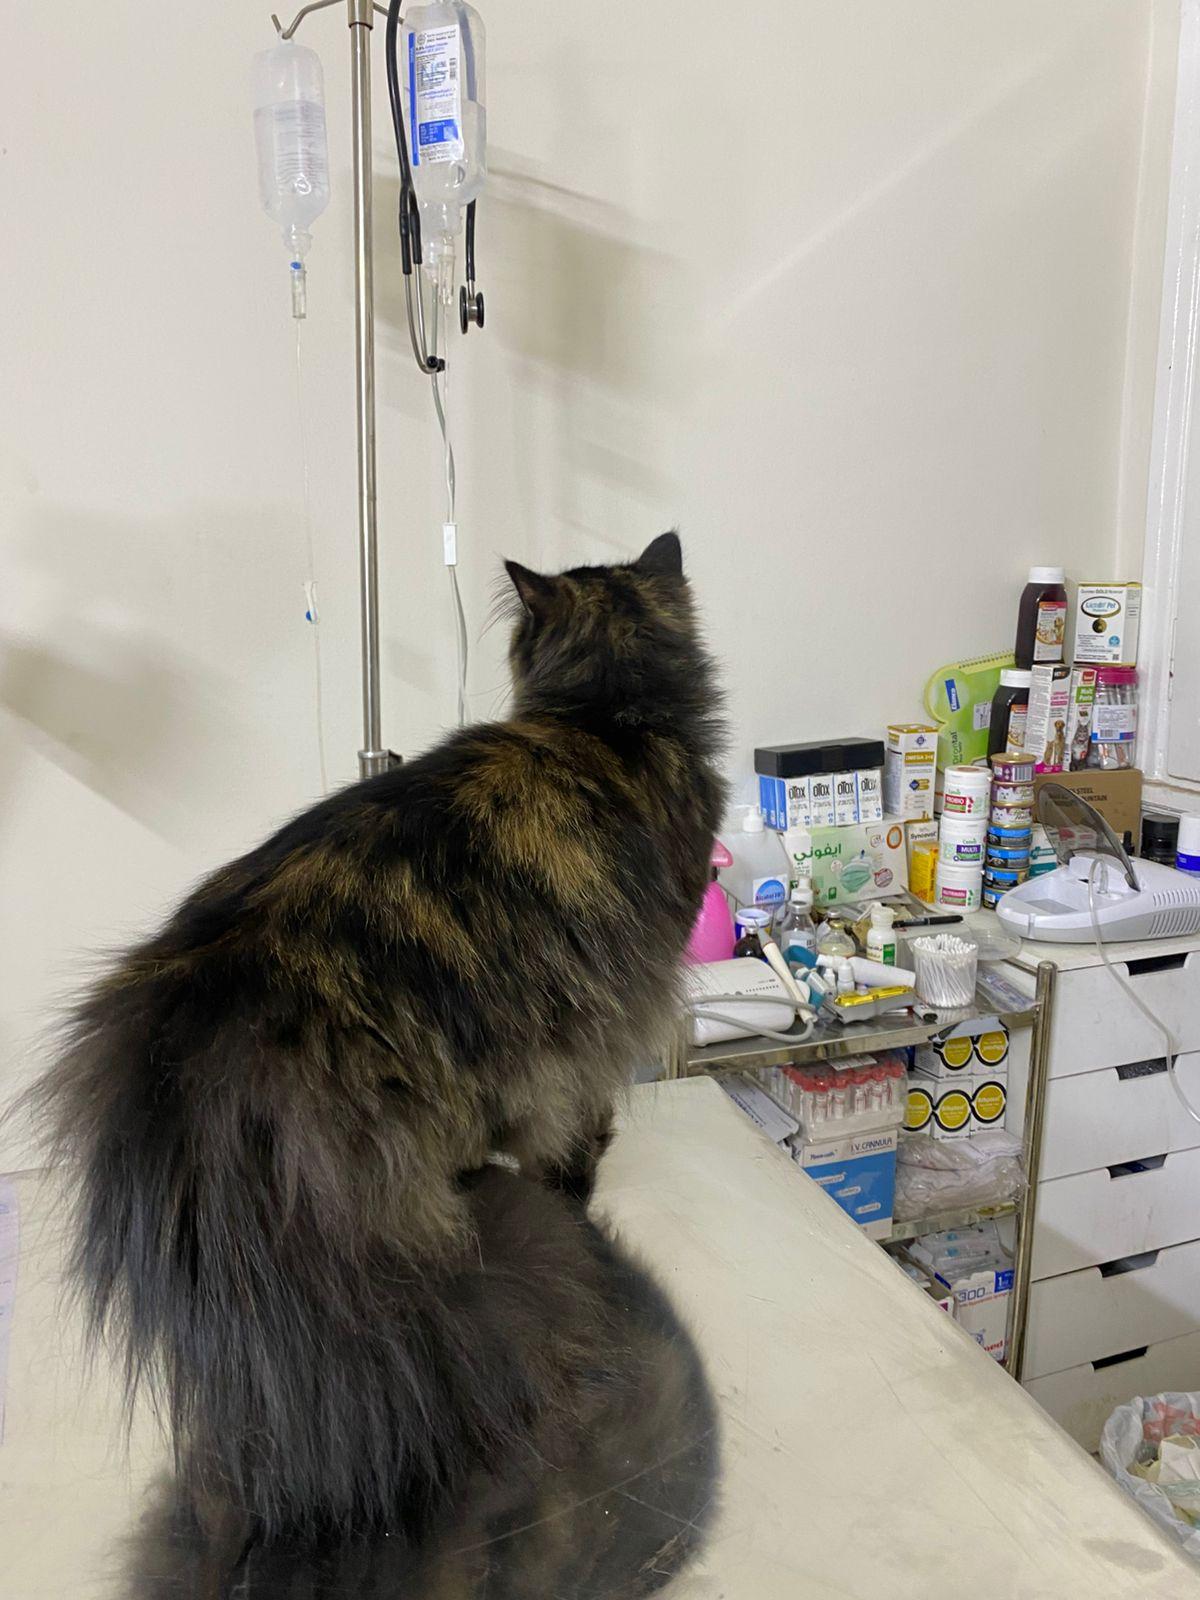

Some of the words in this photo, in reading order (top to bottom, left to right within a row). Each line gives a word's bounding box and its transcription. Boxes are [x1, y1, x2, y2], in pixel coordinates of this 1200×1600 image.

[788, 785, 806, 800] OTOX
[812, 783, 831, 797] OTOX
[837, 781, 855, 795] OTOX
